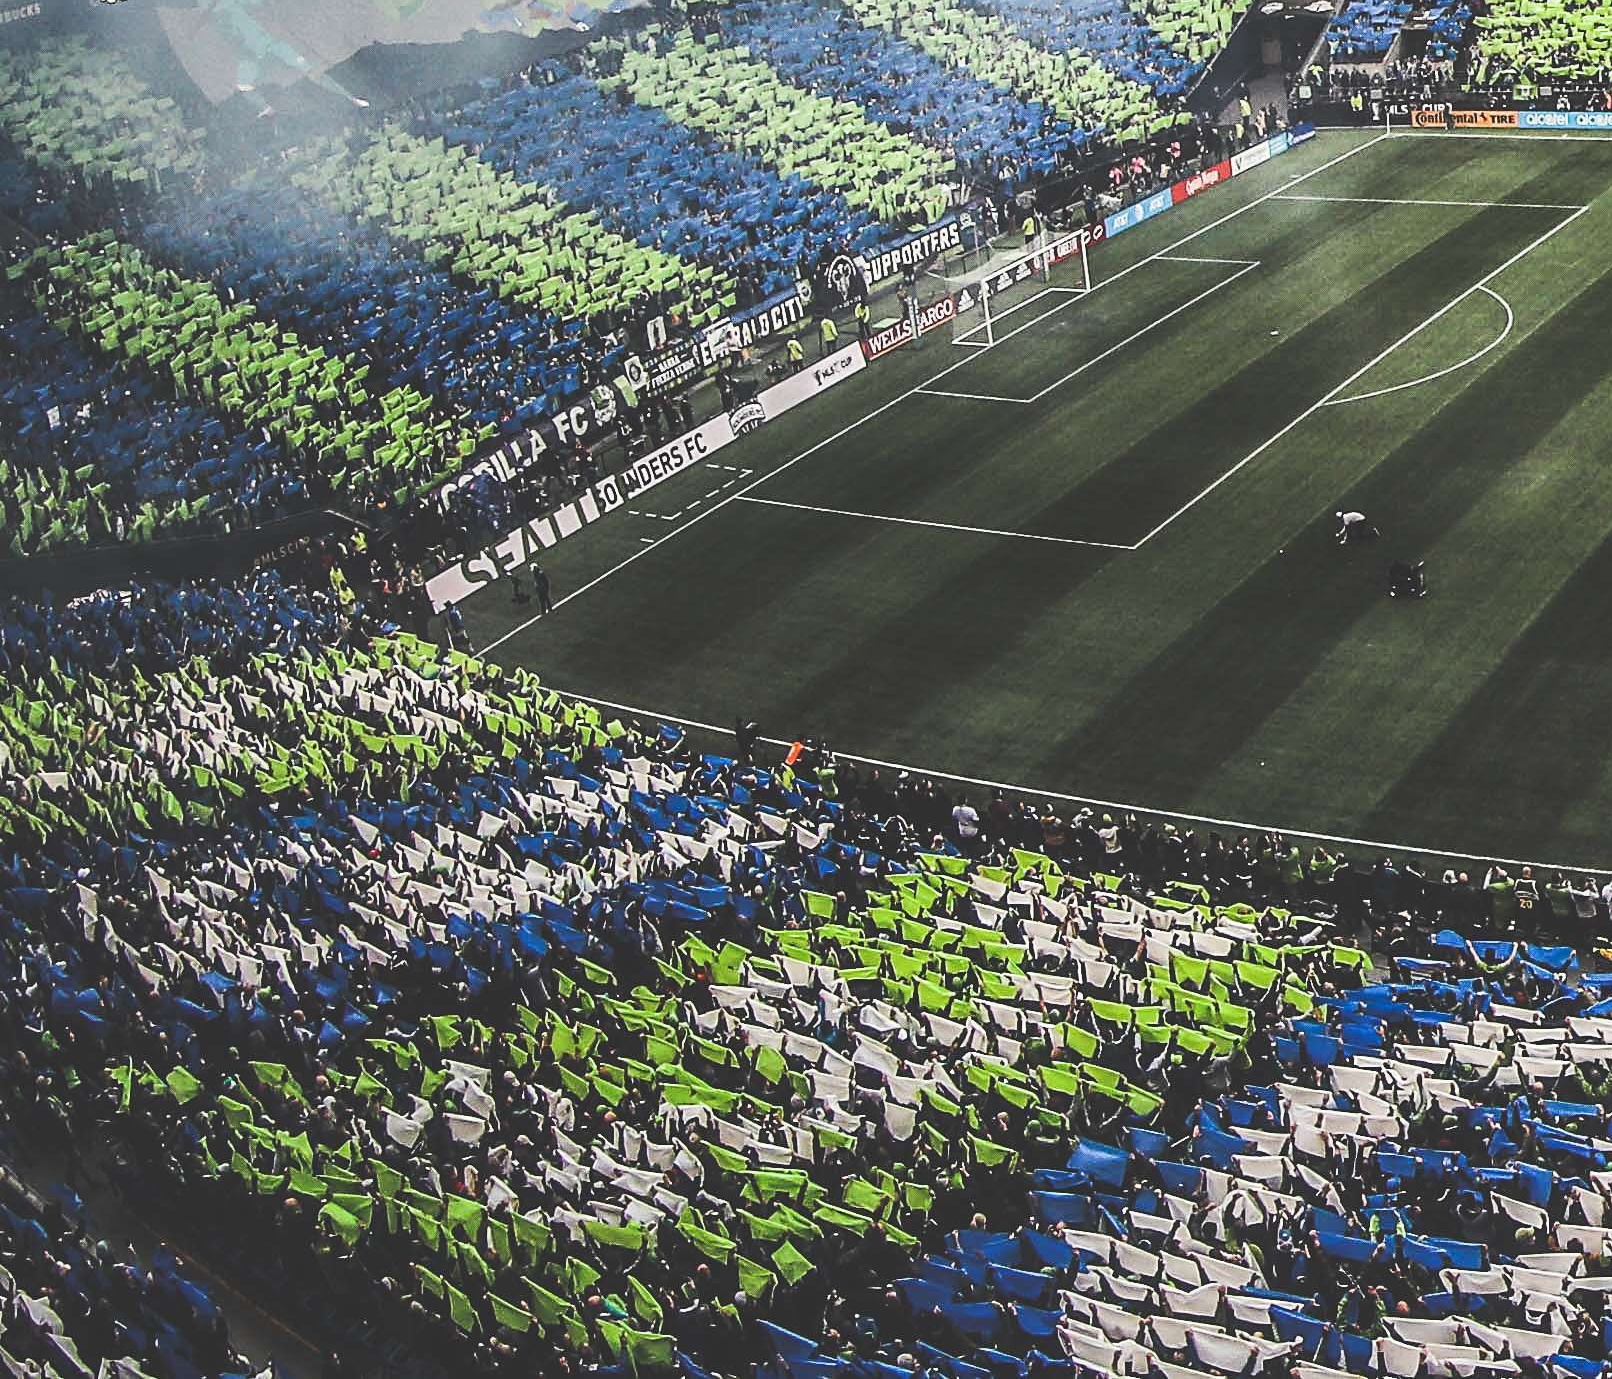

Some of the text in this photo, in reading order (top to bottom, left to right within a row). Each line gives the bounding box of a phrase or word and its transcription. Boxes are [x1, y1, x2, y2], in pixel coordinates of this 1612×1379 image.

[1490, 114, 1515, 124] TIRE
[863, 221, 961, 286] SUPPORTERS
[868, 320, 913, 355] WELLS
[552, 406, 589, 444] FC
[685, 432, 708, 460] FC
